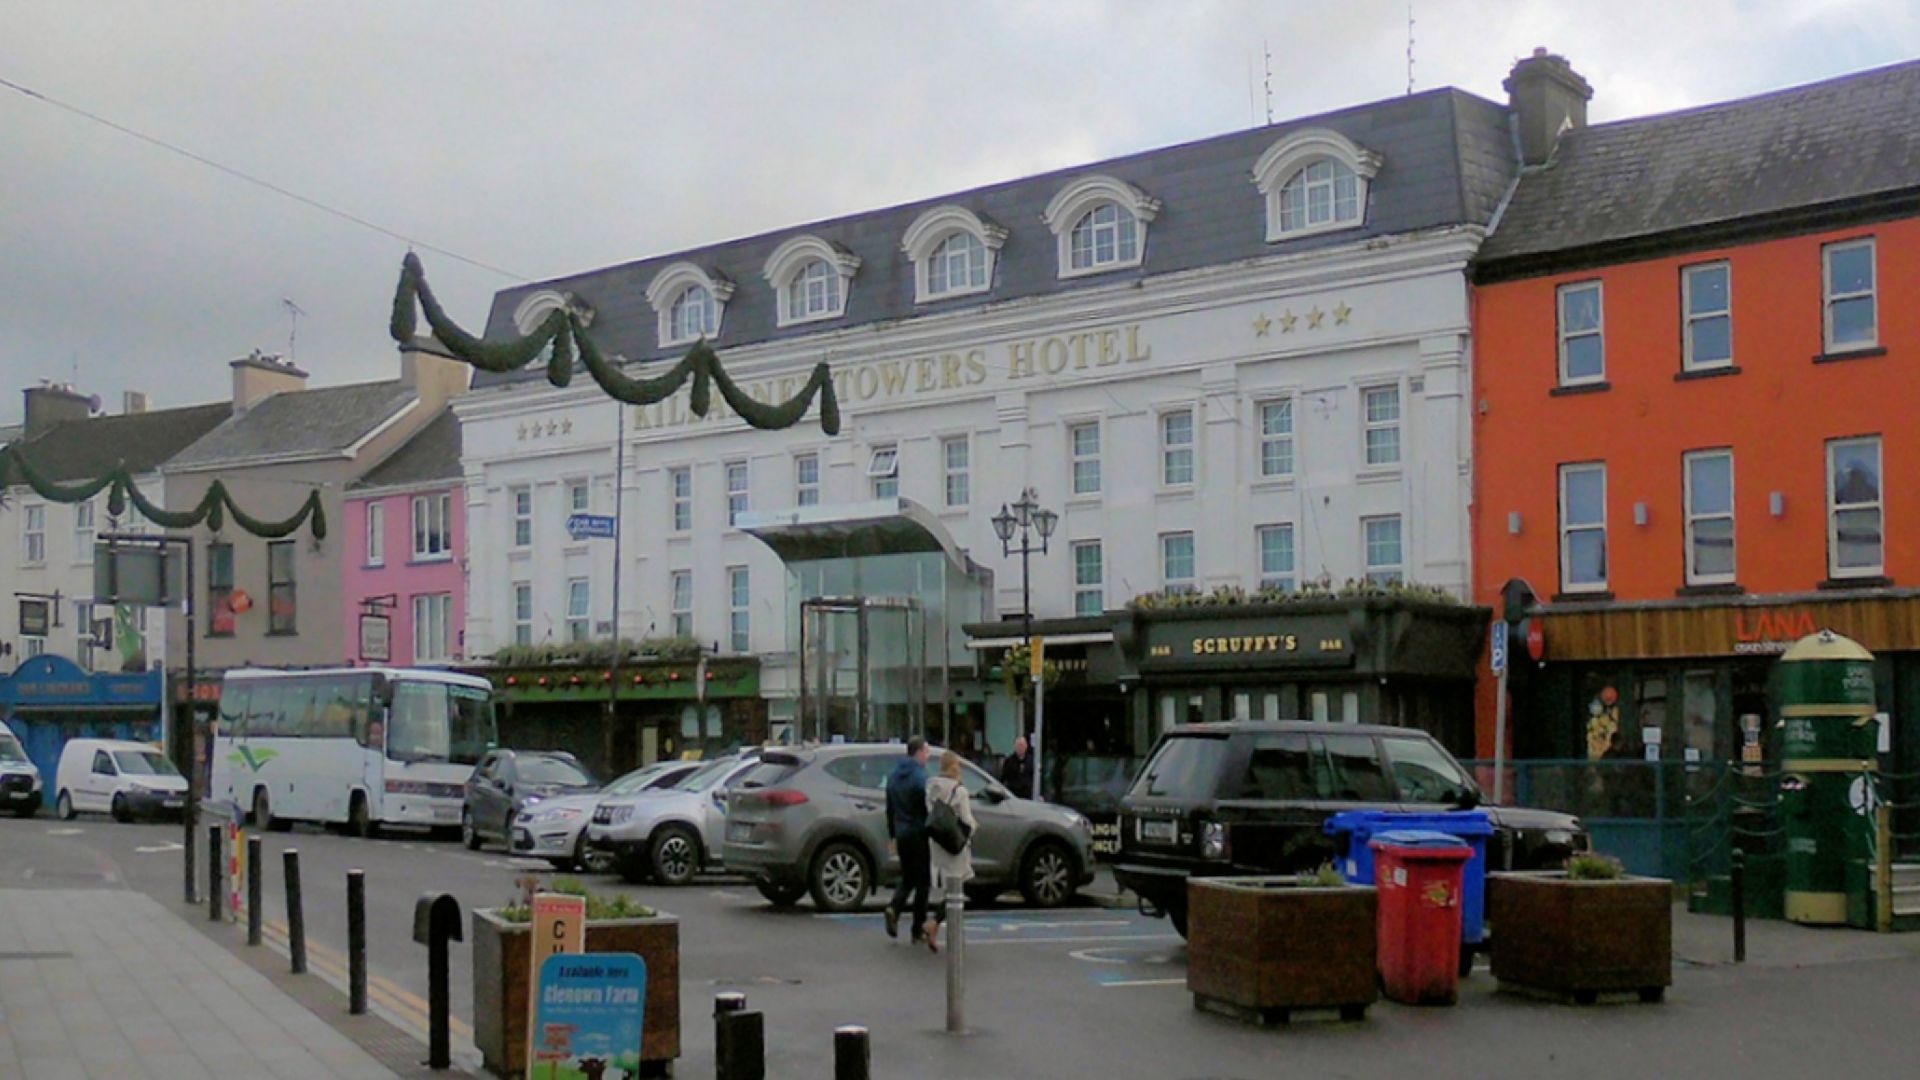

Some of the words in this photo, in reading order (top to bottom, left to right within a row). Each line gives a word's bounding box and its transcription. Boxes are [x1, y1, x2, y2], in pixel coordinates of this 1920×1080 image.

[833, 350, 987, 401] TOWERS
[1008, 324, 1152, 379] HOTEL
[1735, 607, 1817, 642] LANA
[1151, 645, 1171, 656] BAR
[1193, 635, 1297, 654] SCRUFFY'S
[1320, 639, 1343, 650] BAR
[605, 984, 639, 1004] Farm
